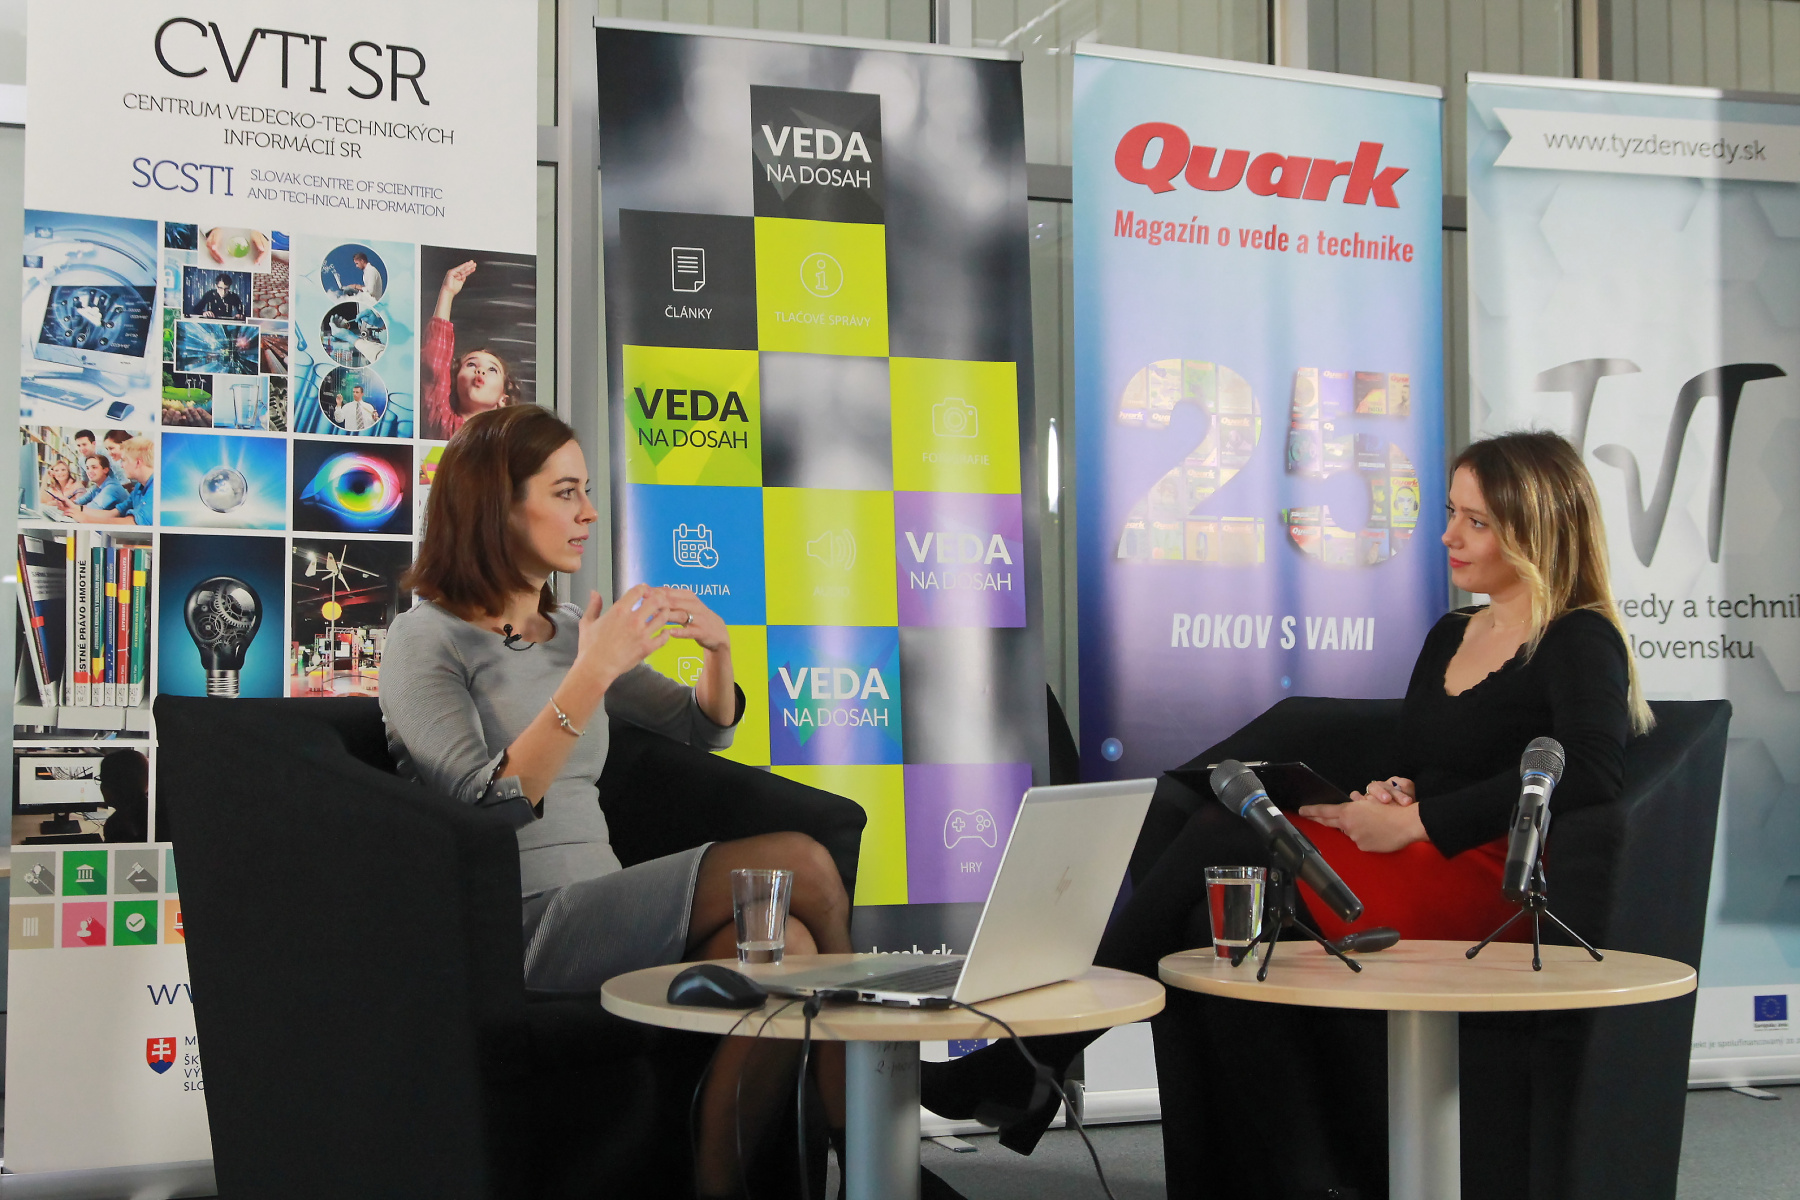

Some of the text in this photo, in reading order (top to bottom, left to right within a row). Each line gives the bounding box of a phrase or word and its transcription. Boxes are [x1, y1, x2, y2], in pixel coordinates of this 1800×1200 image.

[155, 16, 431, 106] CVTI SR
[123, 92, 456, 146] CENTRUM VEDECKO-TECHNICKÝCH
[223, 127, 363, 160] INFORMÁCIÍ SR
[761, 124, 872, 163] VEDA
[1543, 131, 1767, 165] www.tyzdenvedy.sk
[131, 155, 236, 197] SCSTI
[765, 163, 871, 189] NA DOSAH
[1114, 121, 1409, 208] Quark
[250, 168, 443, 200] SLOVAK CENTRE OF SCIENTIFIC
[247, 187, 447, 218] AND TECHNICAL INFORMATION
[1114, 209, 1415, 263] Magazín o vede a technike
[664, 304, 713, 320] ČLÁNKY
[773, 308, 871, 328] TLAČOVÉ SPRÁVY
[633, 386, 749, 423] VEDA
[637, 427, 748, 450] NA DOSAH
[922, 451, 991, 466] FORAFIE
[904, 531, 1013, 565] VEDA
[78, 560, 87, 602] HMOTNÉ
[910, 570, 1012, 591] NA DOSAH
[78, 605, 87, 640] PRÁVO
[1683, 600, 1699, 618] a
[1171, 612, 1376, 651] ROKOV S VAMI
[777, 667, 890, 700] VEDA
[783, 708, 889, 728] NA DOSAH
[960, 860, 982, 873] HRY
